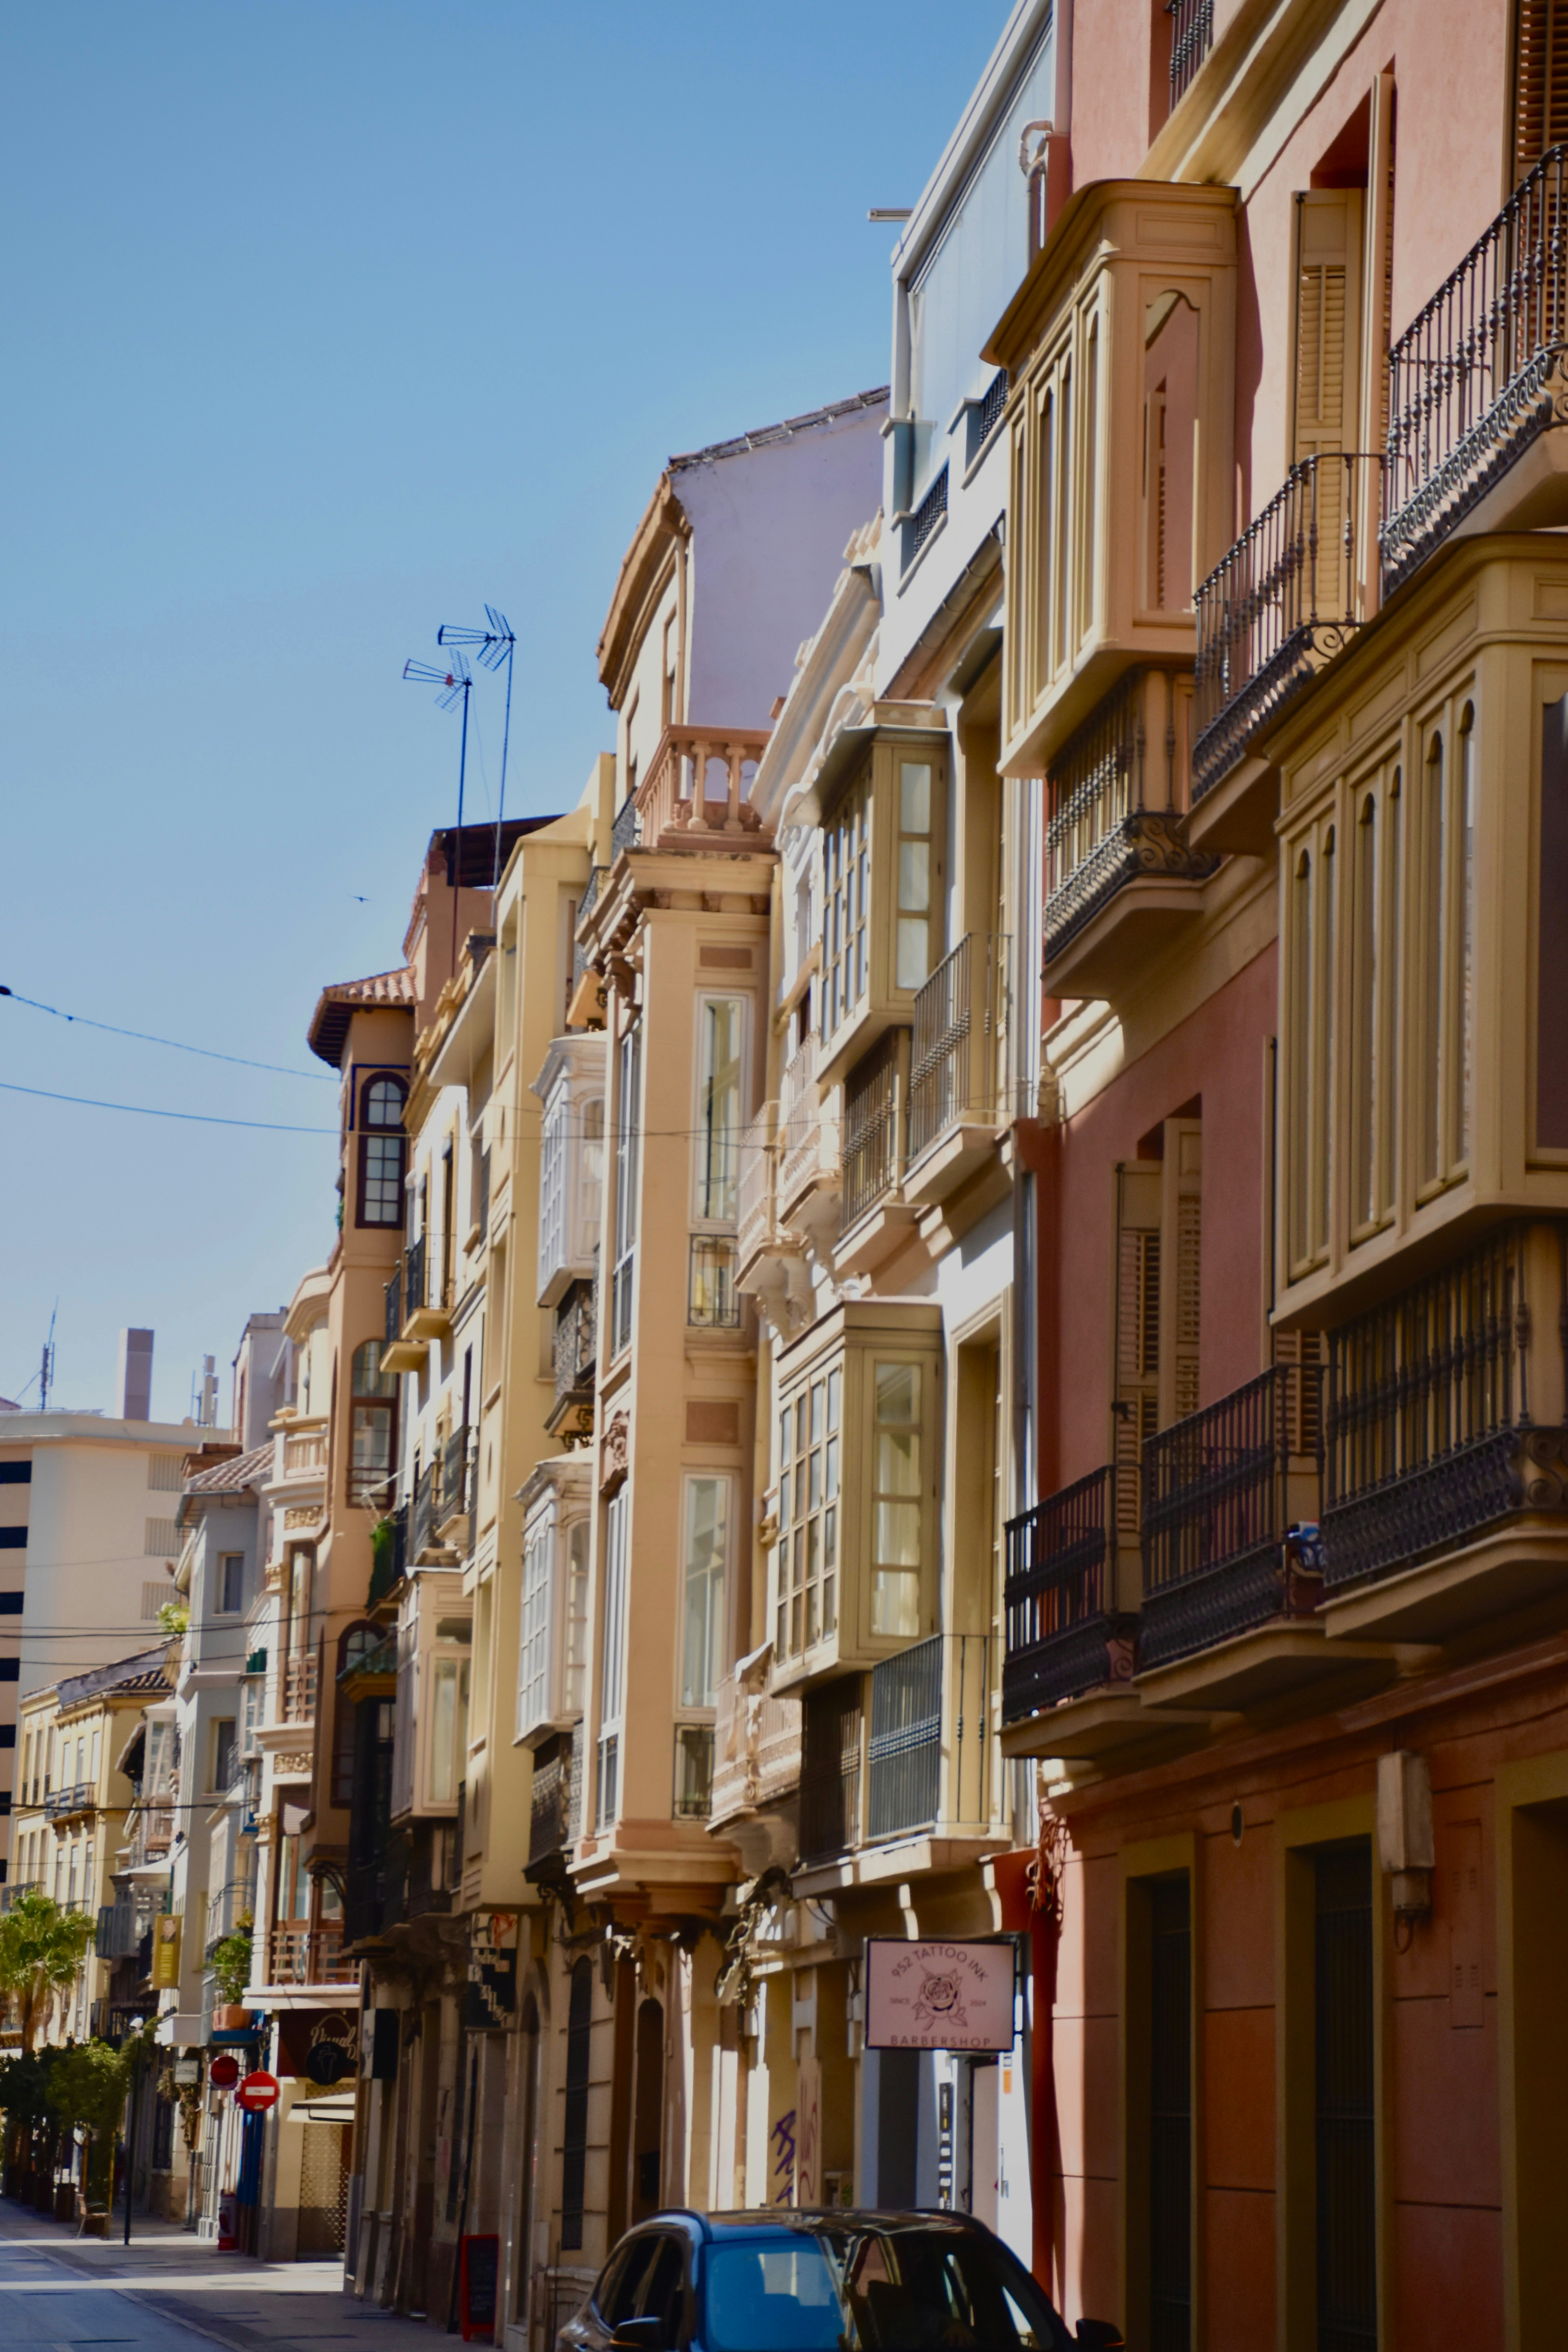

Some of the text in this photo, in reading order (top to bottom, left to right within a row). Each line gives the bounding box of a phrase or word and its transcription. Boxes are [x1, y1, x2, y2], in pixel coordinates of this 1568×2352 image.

[892, 1946, 988, 1982] 952 TATTOO INK
[891, 2035, 990, 2048] BARBERSHOP
